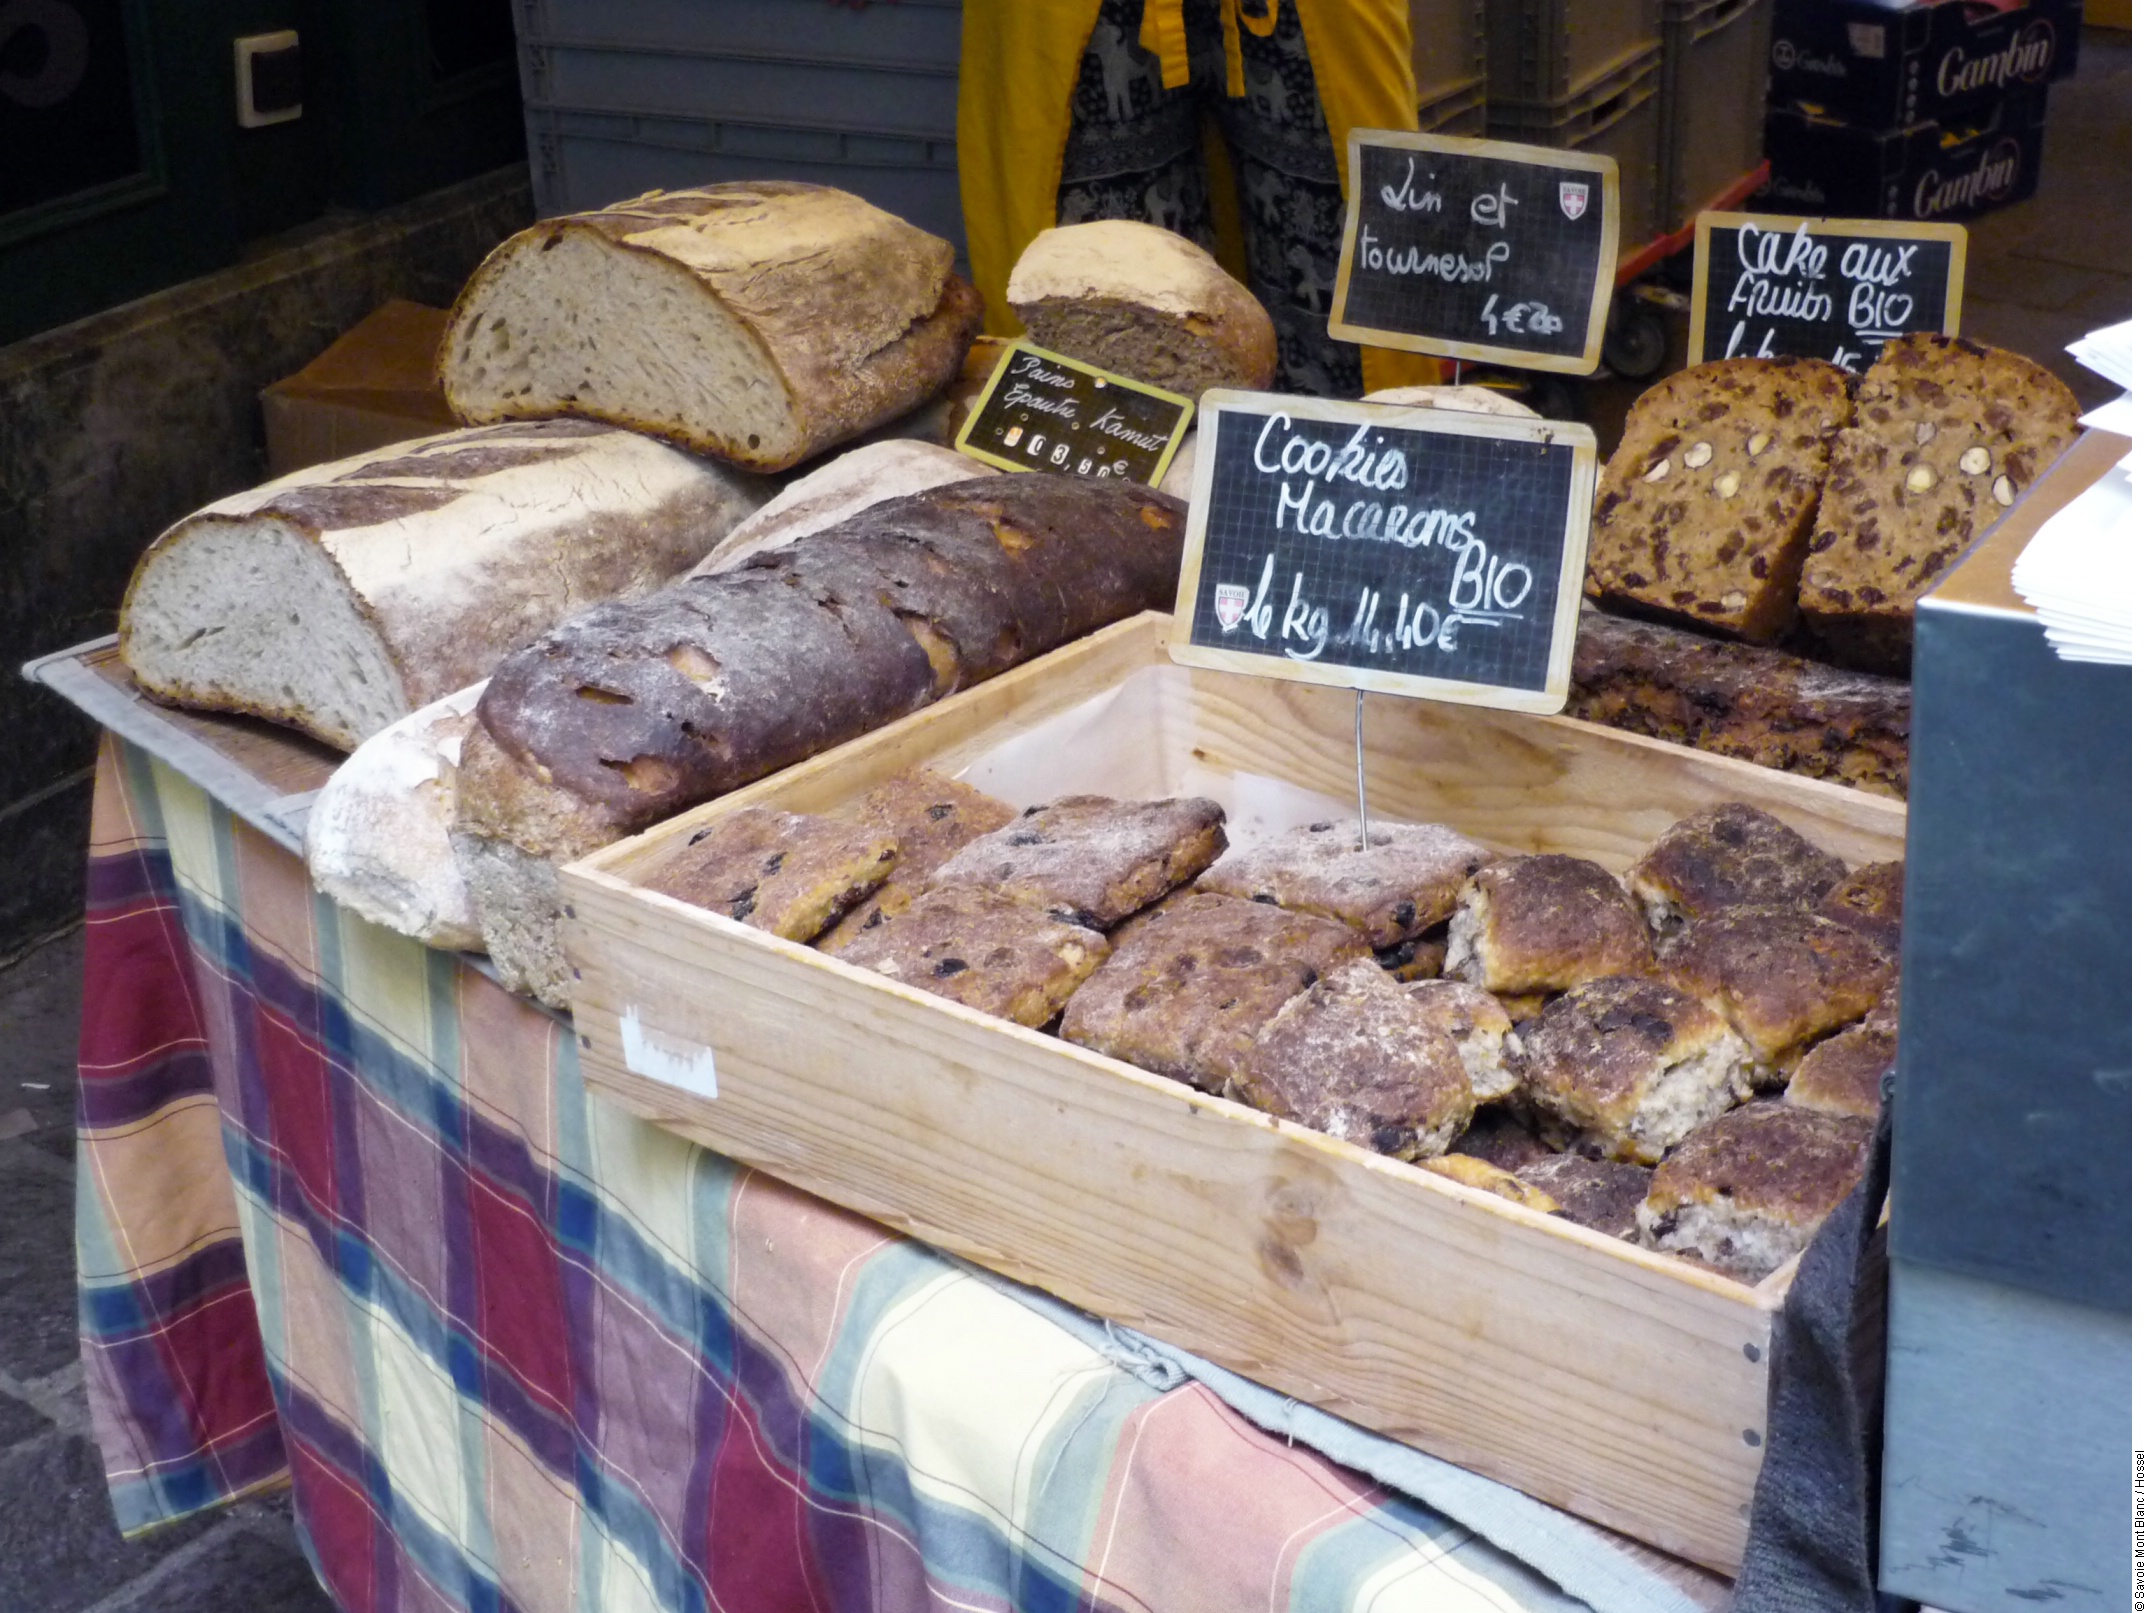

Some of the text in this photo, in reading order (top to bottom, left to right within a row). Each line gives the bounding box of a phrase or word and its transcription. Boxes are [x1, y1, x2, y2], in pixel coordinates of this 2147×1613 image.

[1937, 29, 2050, 97] Gambin
[1471, 183, 1519, 228] et
[1914, 150, 2015, 219] Gambin
[1361, 224, 1510, 282] tournesol
[1738, 222, 1918, 286] Cake aux
[1849, 282, 1913, 328] BIO
[1011, 356, 1075, 389] Pains
[1089, 407, 1169, 452] Kamut
[1254, 411, 1409, 491] Cookies
[1276, 480, 1476, 552] Macarons
[1449, 539, 1532, 610] BIO
[1282, 572, 1328, 661] kg
